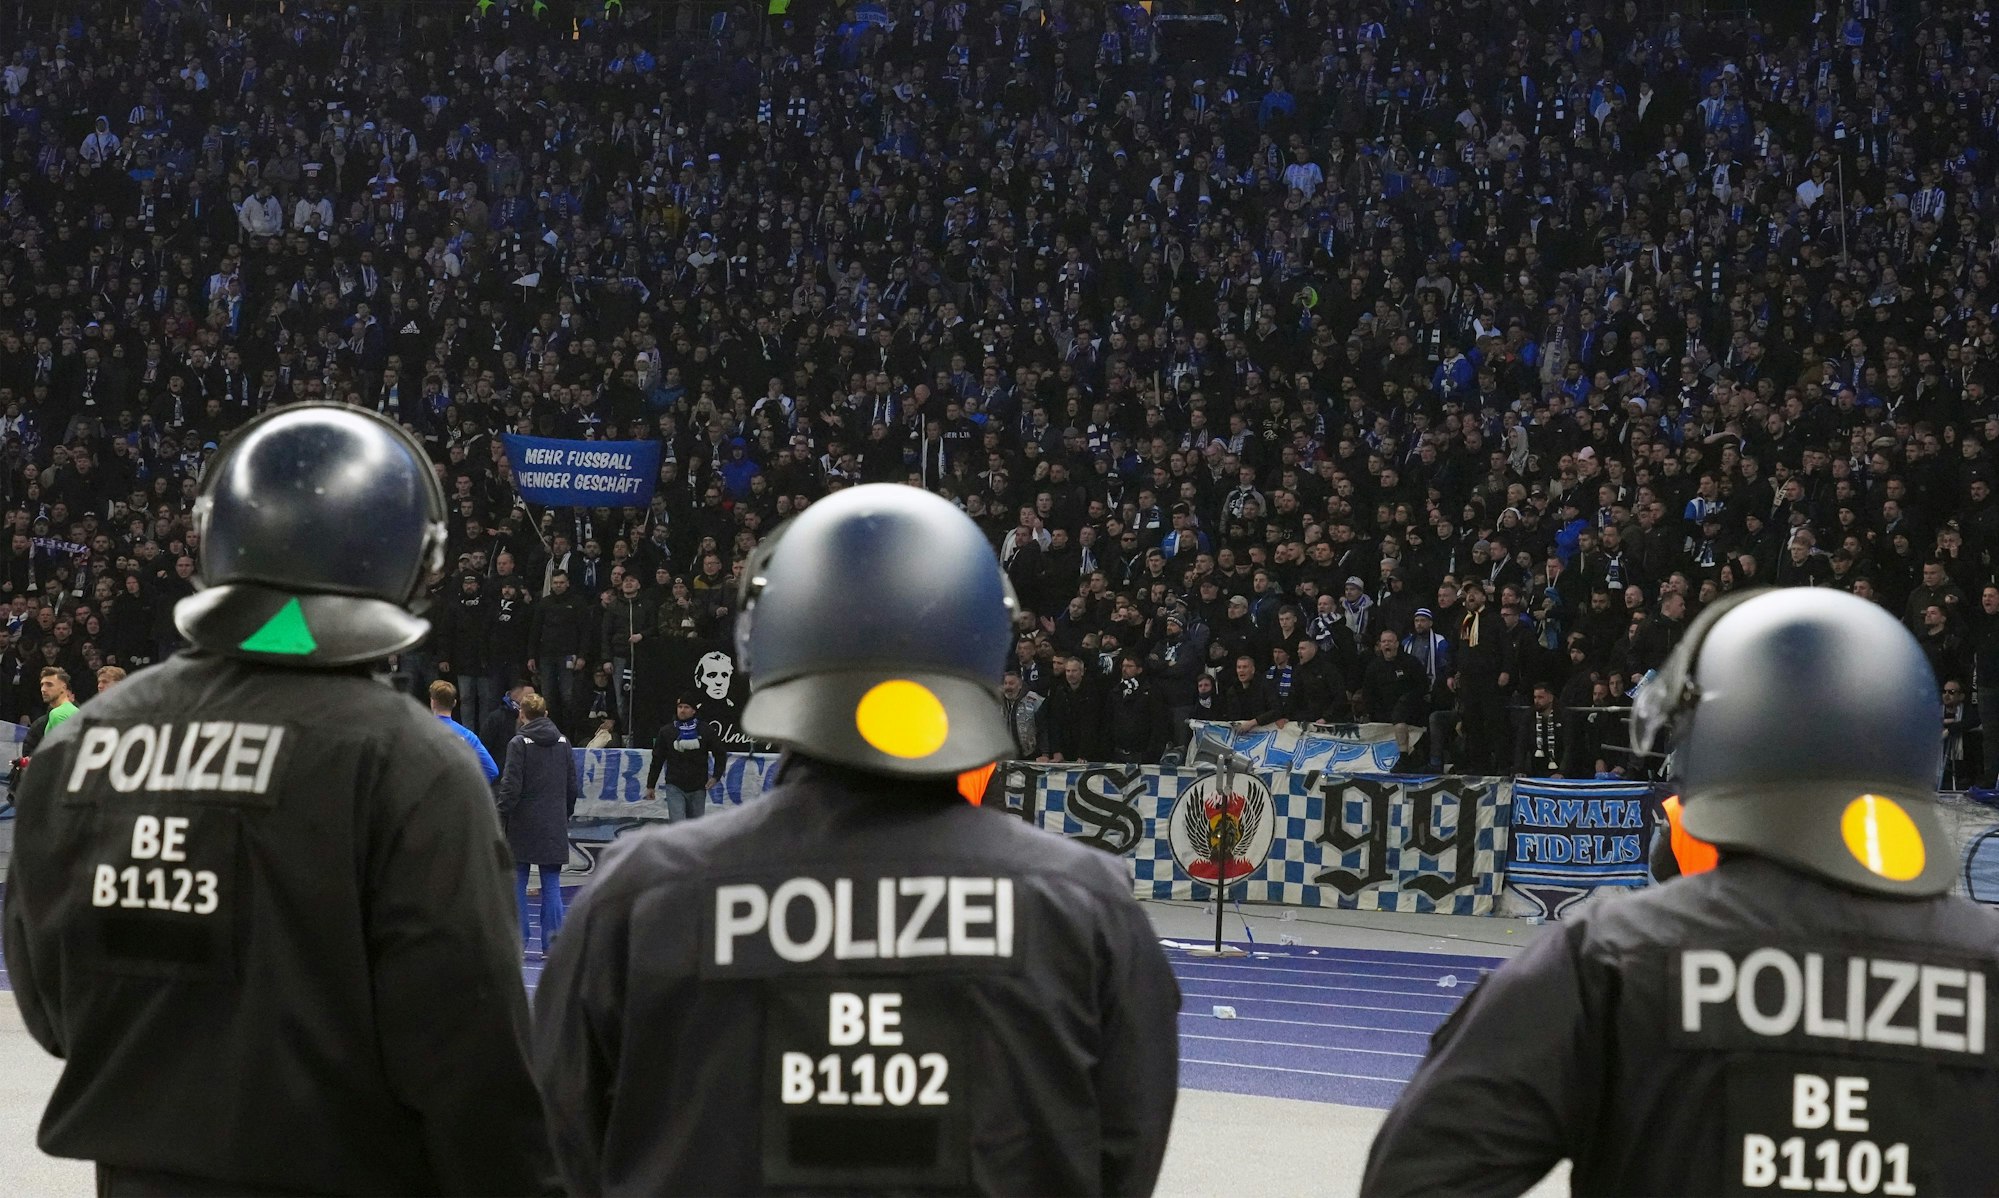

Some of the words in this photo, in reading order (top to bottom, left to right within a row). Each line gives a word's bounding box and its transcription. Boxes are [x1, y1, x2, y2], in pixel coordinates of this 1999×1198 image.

[518, 471, 571, 489] WENIGER
[574, 473, 643, 494] GESCHÄFT
[525, 448, 564, 465] MEHR
[567, 450, 632, 470] FUSSBALL
[68, 723, 284, 793] POLIZEI
[131, 815, 190, 861] BE
[1515, 795, 1644, 828] ARMATA
[1515, 833, 1642, 865] FIDELIS
[92, 864, 219, 914] B1123
[715, 877, 1014, 966] POLIZEI
[829, 992, 903, 1047] BE
[1681, 948, 1986, 1054] POLIZEI
[781, 1053, 949, 1106] B1102
[1793, 1074, 1869, 1132] BE
[1743, 1134, 1917, 1196] B1101
